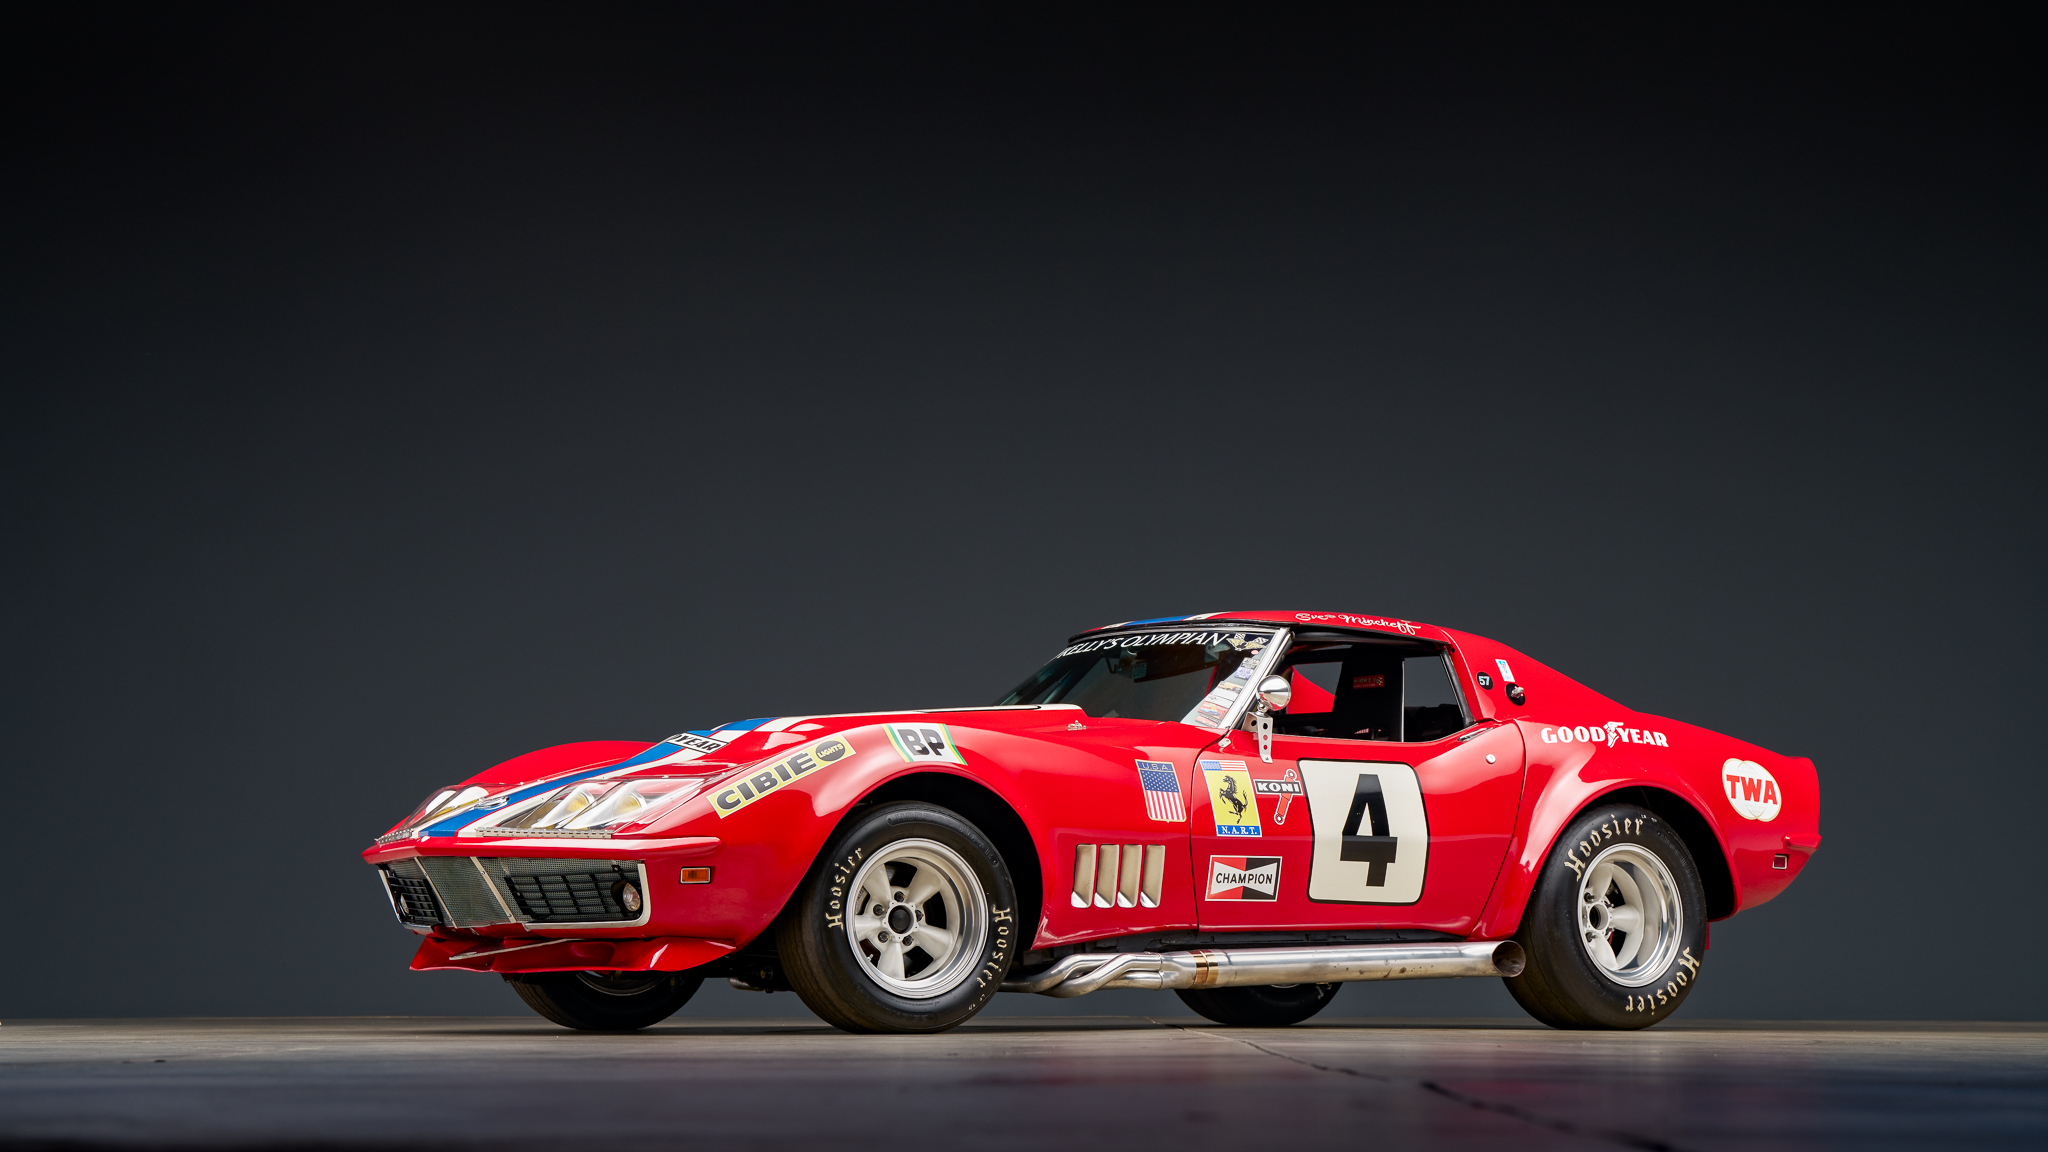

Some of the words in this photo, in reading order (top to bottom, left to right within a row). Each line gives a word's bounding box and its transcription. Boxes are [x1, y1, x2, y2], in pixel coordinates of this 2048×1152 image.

[1121, 632, 1229, 647] OLYMPIAN
[1478, 675, 1490, 686] 57
[670, 733, 722, 751] YEAR
[817, 742, 844, 759] LIGHTS
[897, 728, 945, 756] BP
[1141, 762, 1172, 771] U.S.A.
[1257, 782, 1300, 793] KONI
[1726, 774, 1778, 805] TWA
[1221, 826, 1258, 835] N.A.R.T.
[1340, 773, 1398, 887] 4
[1564, 814, 1644, 882] Hoosier
[1215, 872, 1273, 885] CHAMPION
[825, 847, 863, 931] Hoosier
[976, 903, 1012, 989] Hoosier
[1625, 947, 1700, 1015] Hoosier
